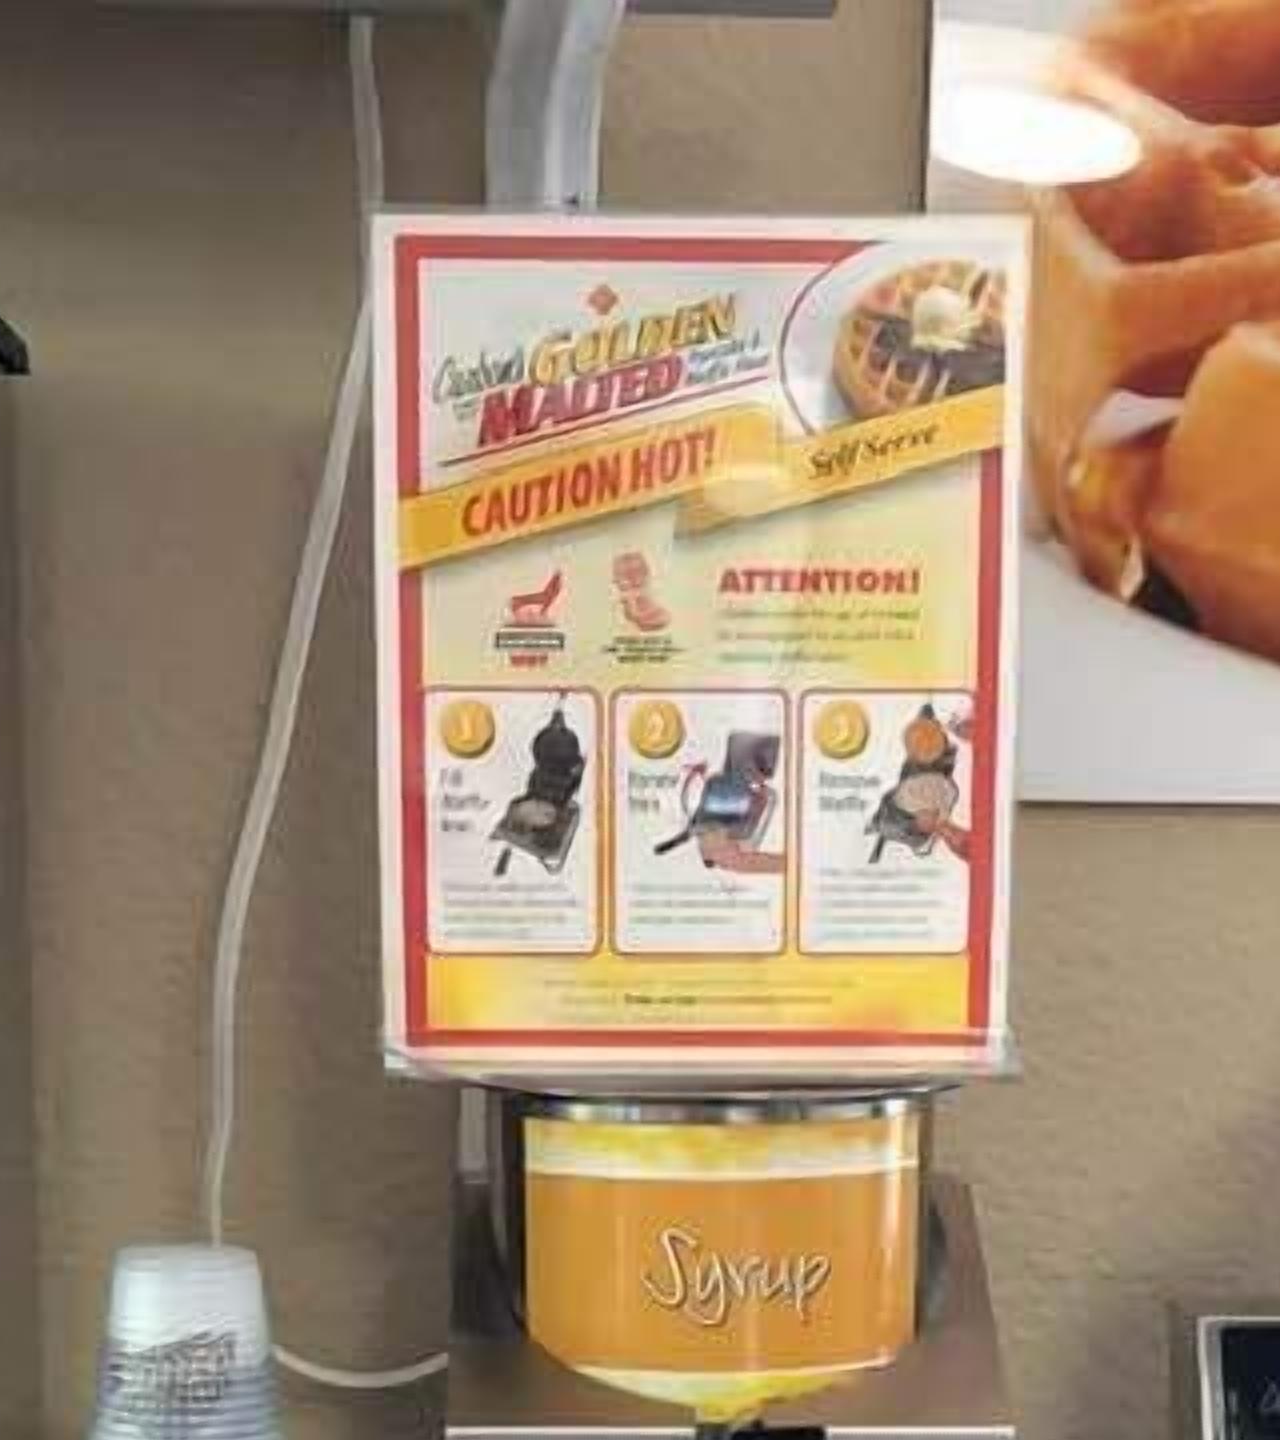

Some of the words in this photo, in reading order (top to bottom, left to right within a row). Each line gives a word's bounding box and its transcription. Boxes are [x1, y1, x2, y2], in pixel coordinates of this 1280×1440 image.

[528, 293, 736, 386] GOLDEN
[477, 354, 683, 447] MALTED
[461, 461, 620, 537] CAUTION
[629, 428, 718, 494] HOT!
[806, 443, 859, 480] Self
[862, 424, 940, 459] Serve
[720, 568, 919, 595] ATTENTION!
[640, 1227, 832, 1327] Syrup
